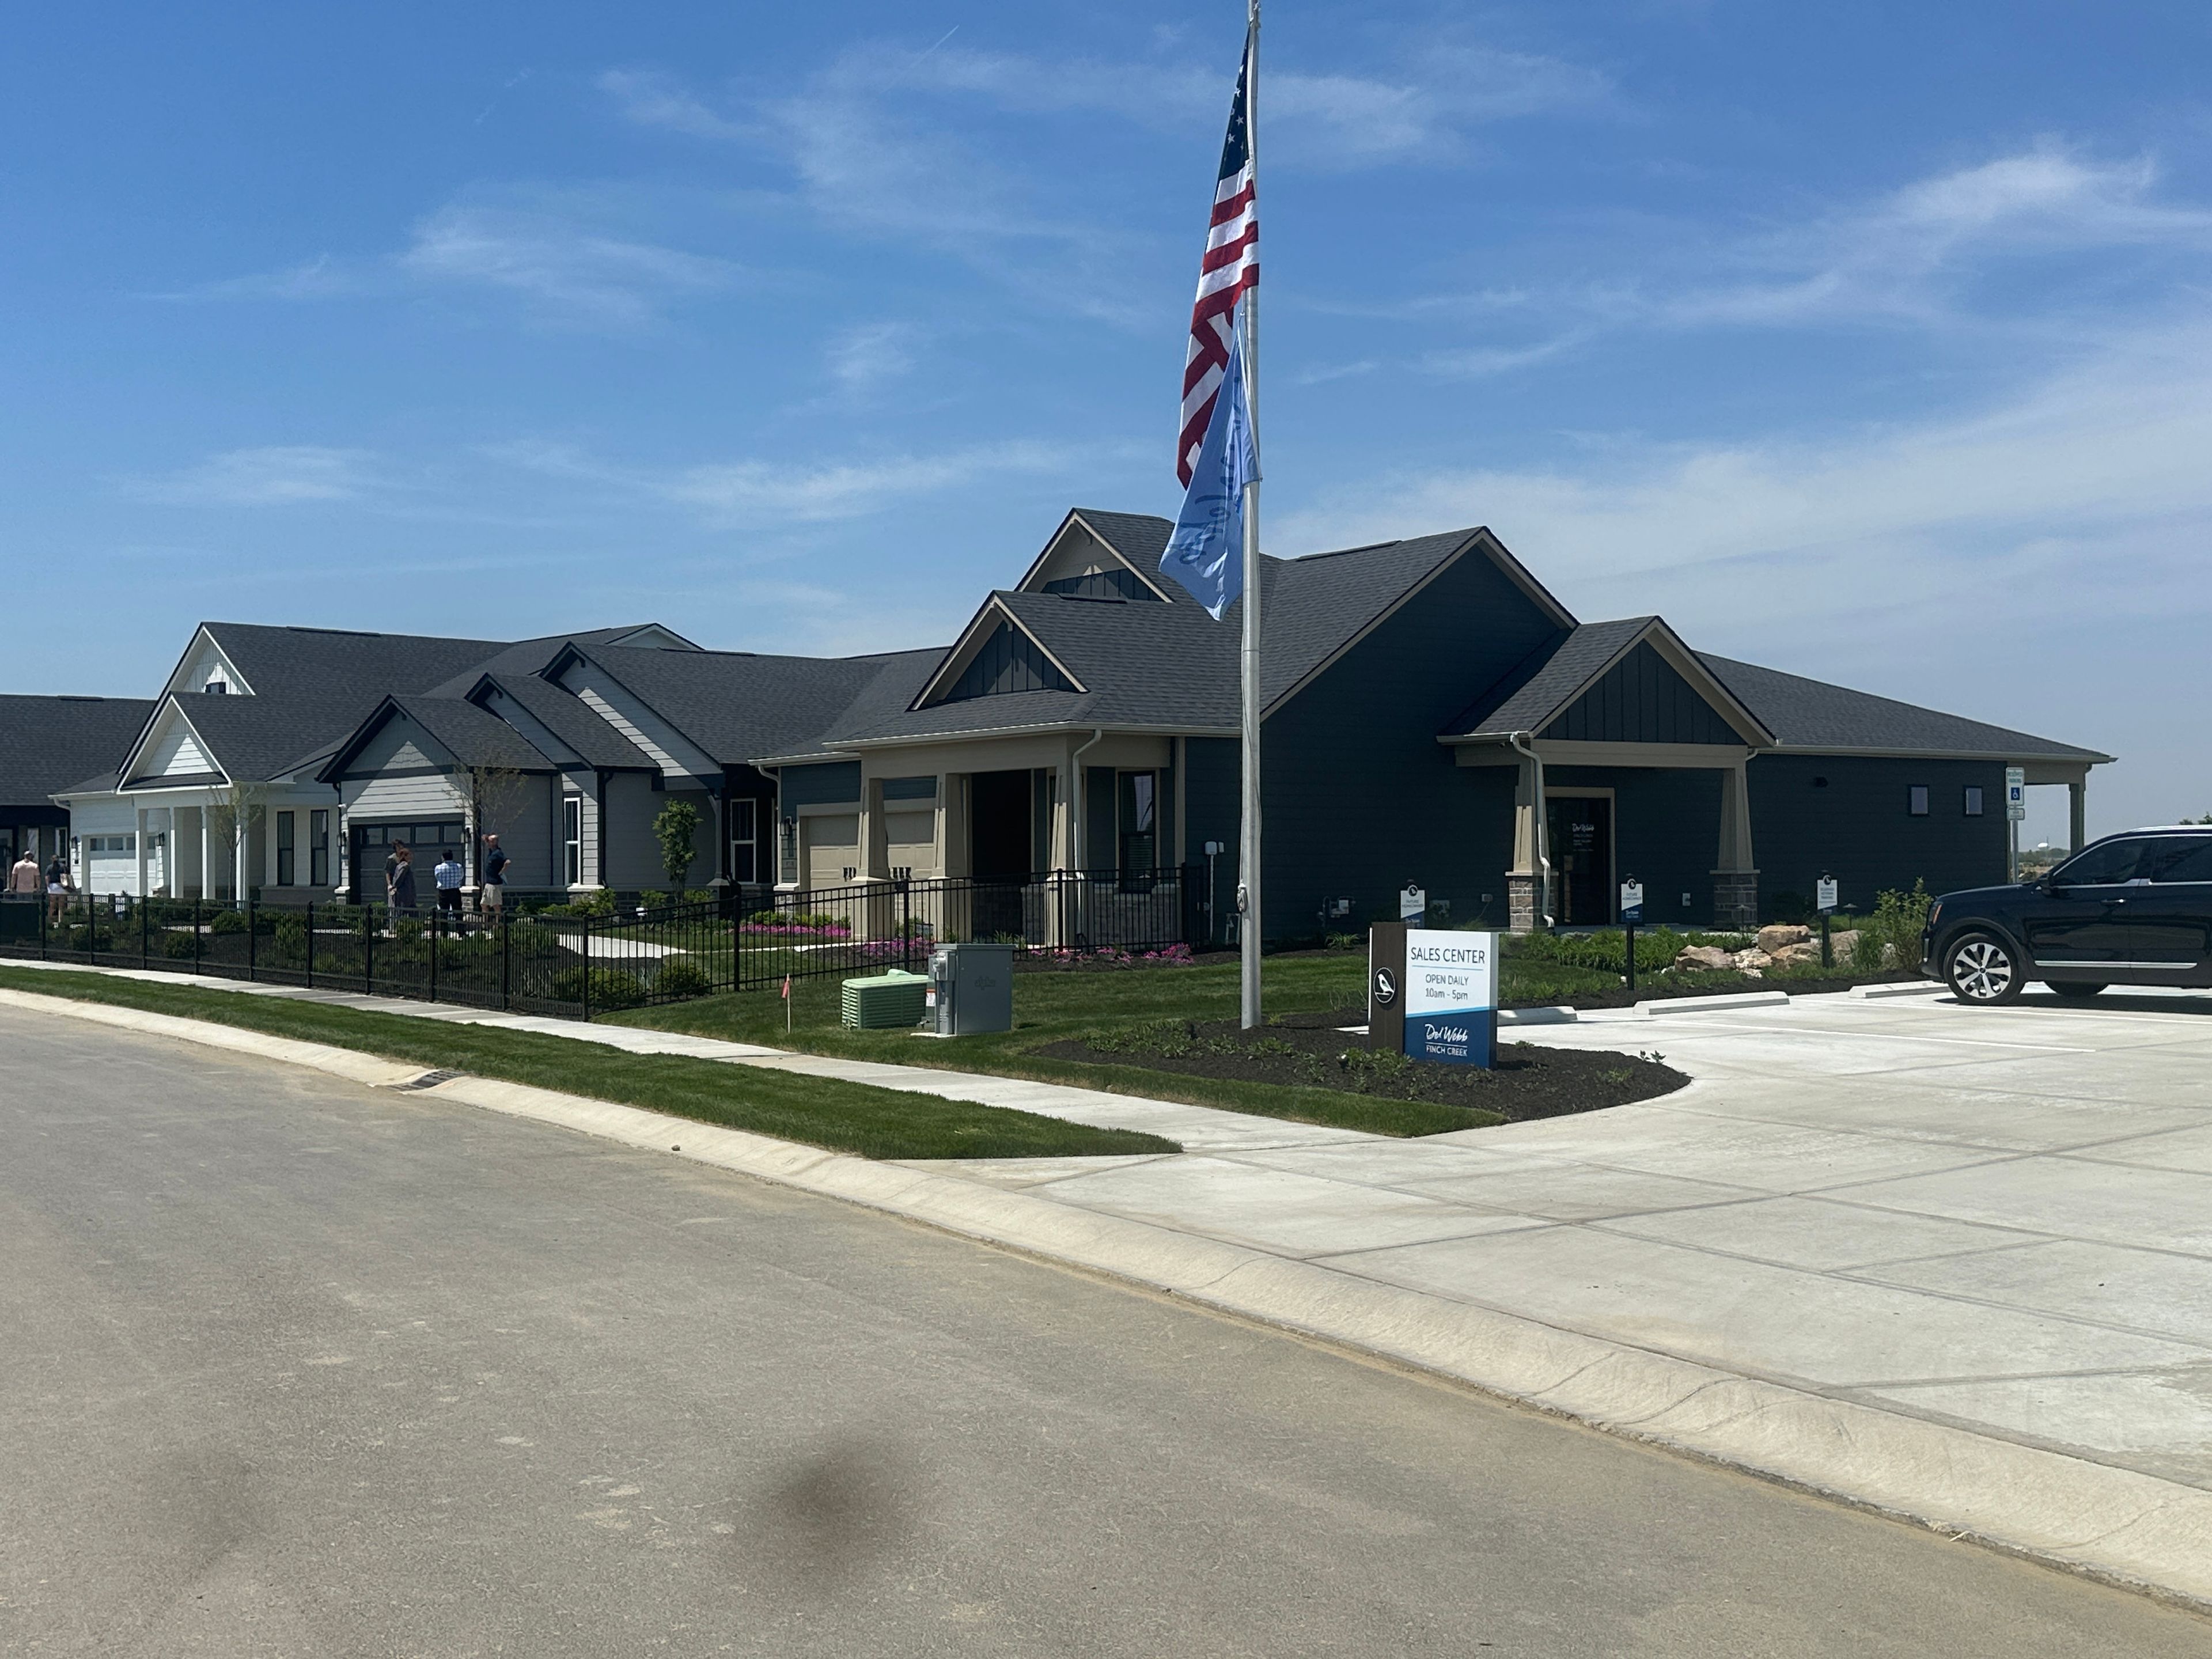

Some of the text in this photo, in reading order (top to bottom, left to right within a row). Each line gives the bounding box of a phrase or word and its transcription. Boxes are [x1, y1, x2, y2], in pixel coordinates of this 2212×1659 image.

[1411, 946, 1485, 964] SALES CENTER
[1425, 974, 1469, 986] OPEN DAILY
[1425, 987, 1445, 998] 10am
[1452, 990, 1468, 1002] 5pm
[1425, 1024, 1468, 1042] Del Webb
[1426, 1045, 1468, 1057] FINCH CREEK
